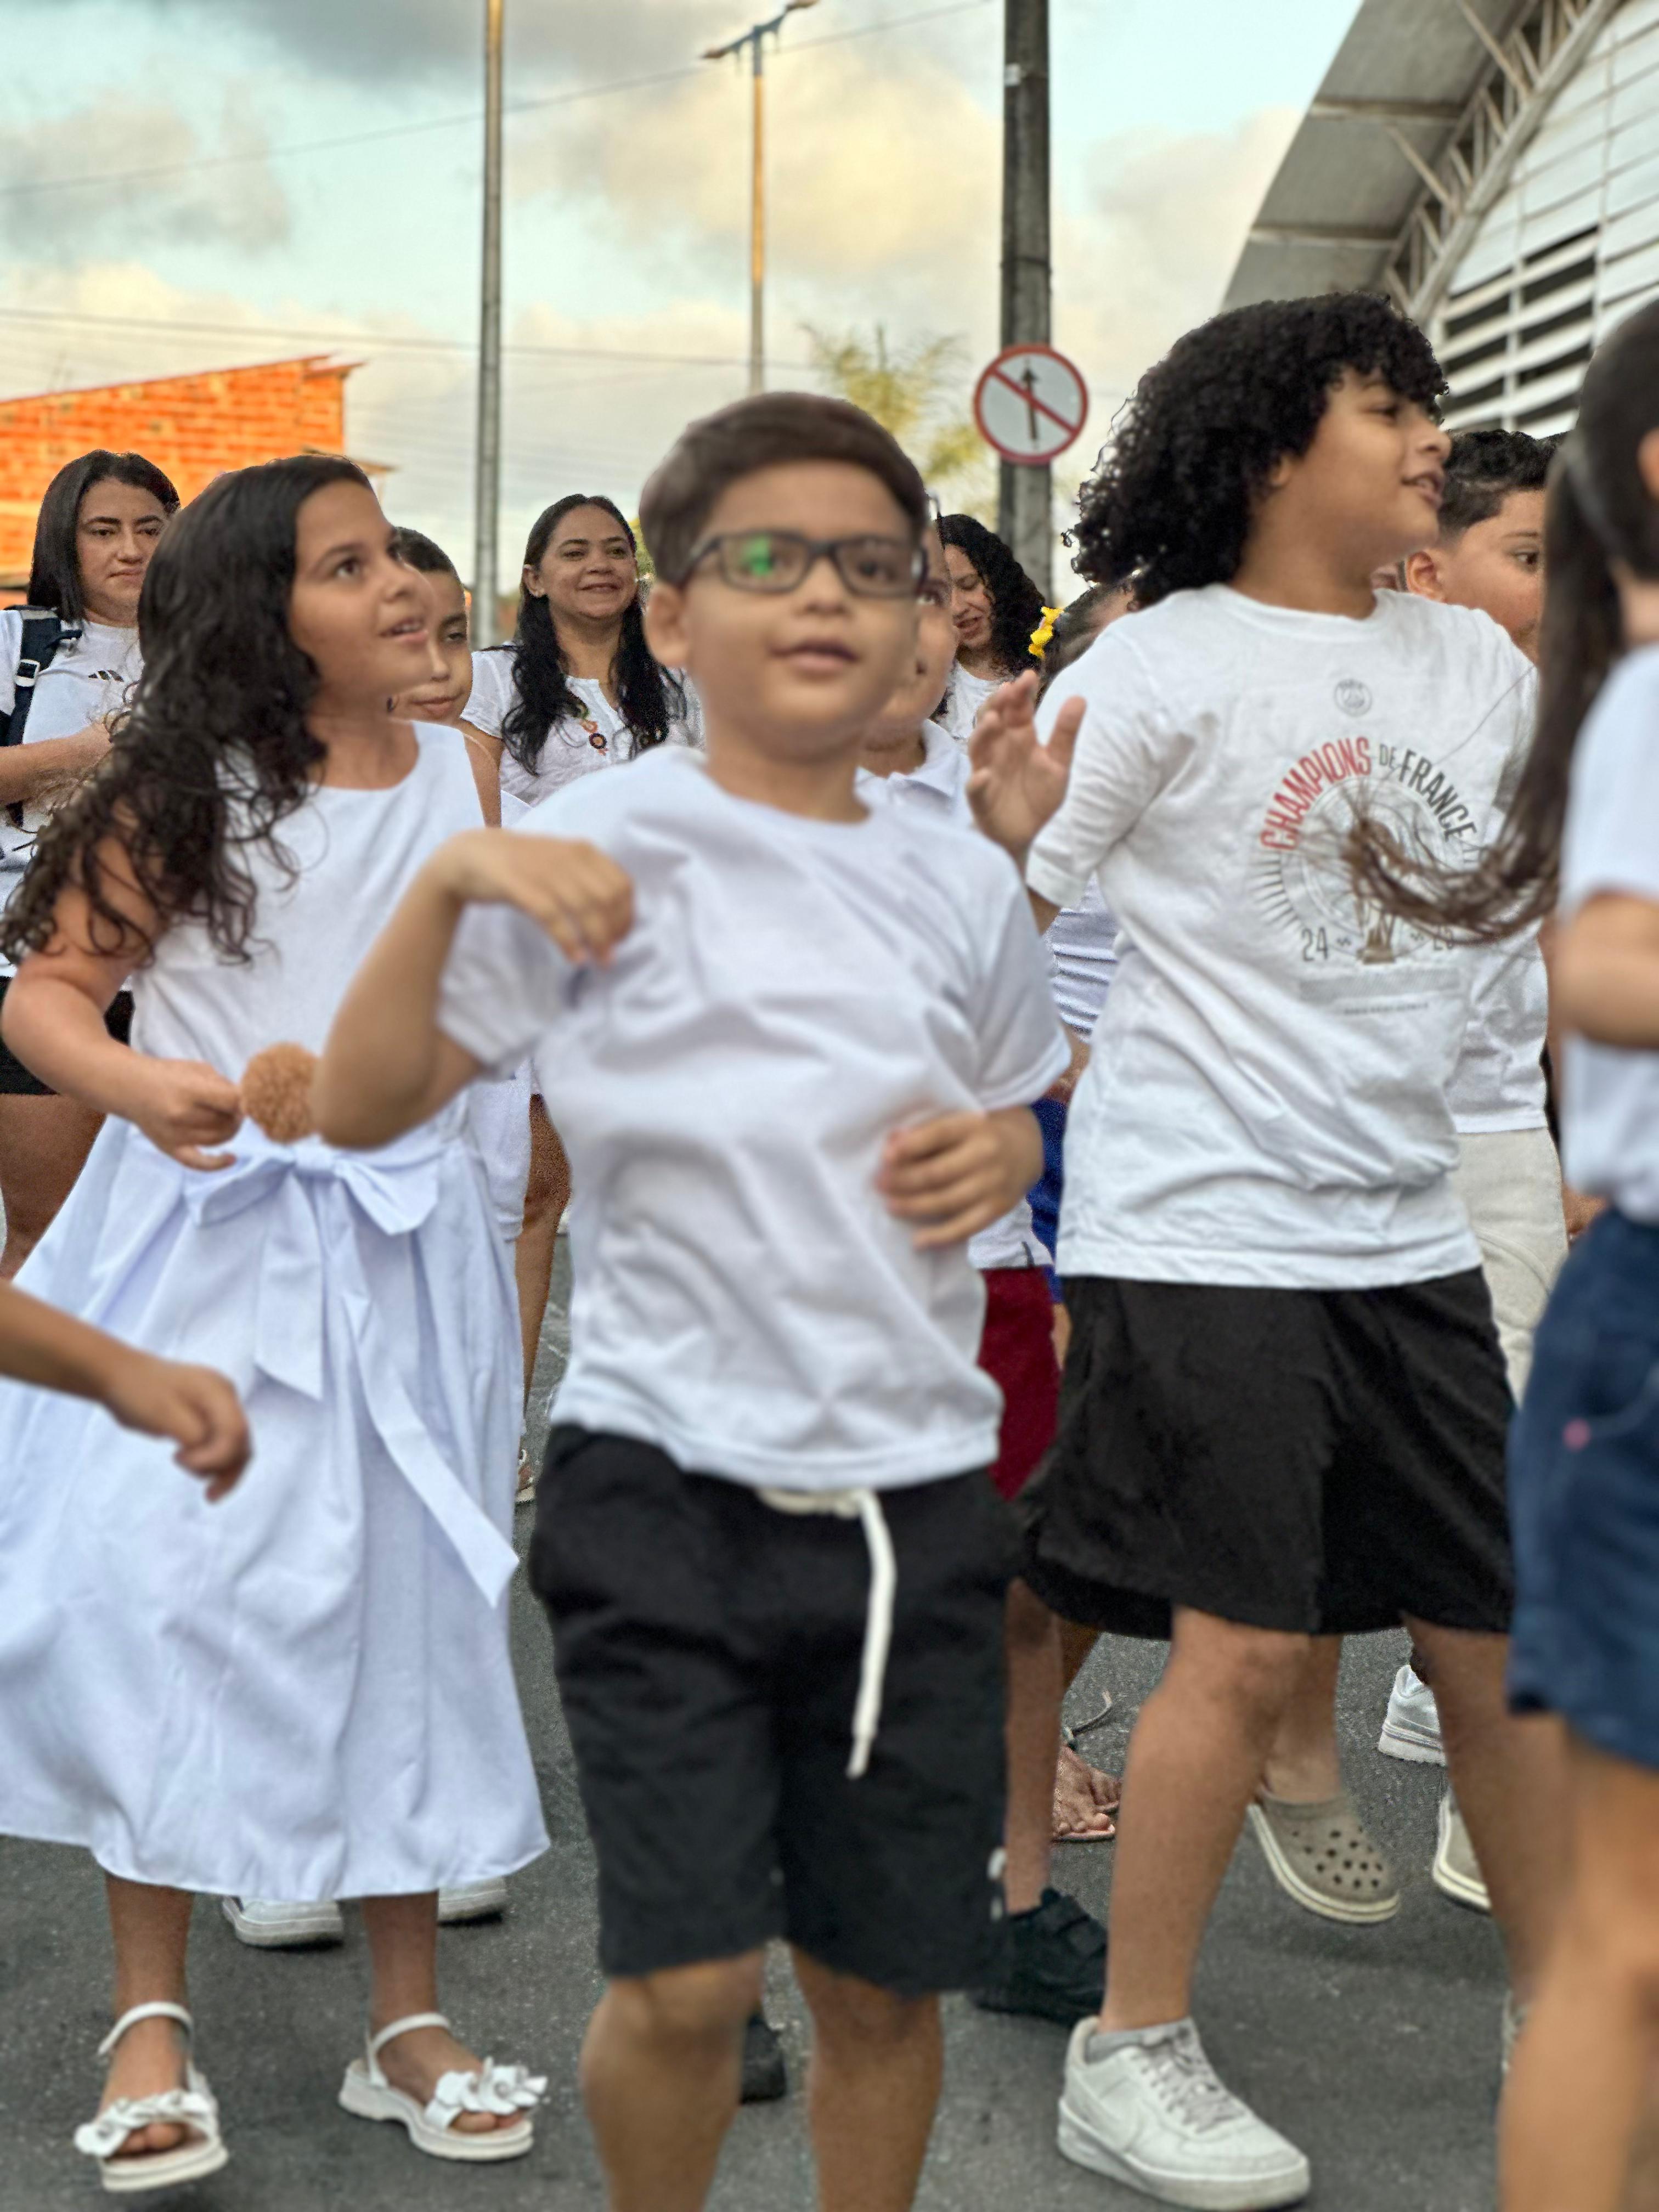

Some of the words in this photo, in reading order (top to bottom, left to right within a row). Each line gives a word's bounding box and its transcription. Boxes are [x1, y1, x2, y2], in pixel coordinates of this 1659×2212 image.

[1260, 736, 1372, 851] CHAMPIONS
[1379, 743, 1397, 769] DE
[1398, 748, 1477, 843] FRANCE
[1301, 926, 1328, 962] 24
